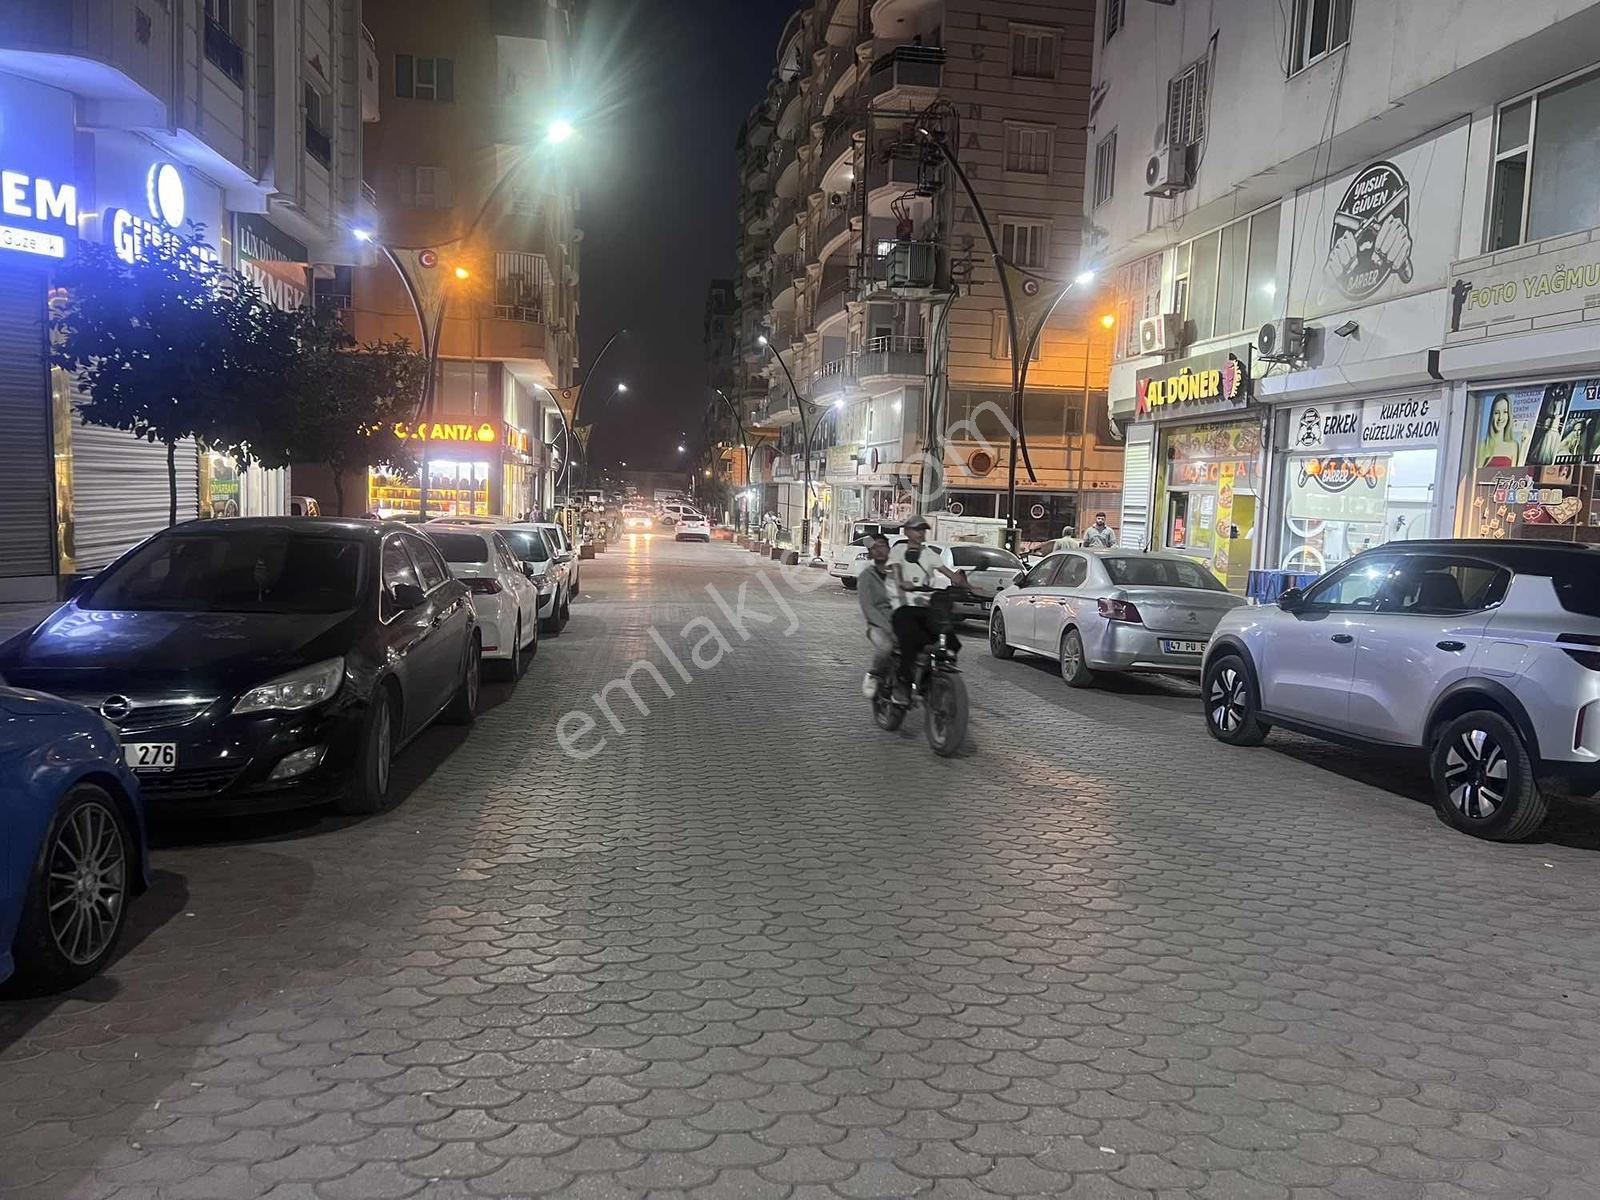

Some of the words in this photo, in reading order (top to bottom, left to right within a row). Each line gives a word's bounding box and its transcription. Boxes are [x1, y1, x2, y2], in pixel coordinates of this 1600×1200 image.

[1353, 171, 1390, 200] YUSUF
[2, 170, 76, 226] EM
[1352, 189, 1389, 216] GÜVEN
[1467, 281, 1518, 311] FOTO
[1167, 367, 1220, 404] DÖNER
[1380, 398, 1418, 420] KUAFÖR
[1420, 400, 1430, 416] &
[1323, 413, 1358, 435] ERKEK
[1405, 420, 1441, 439] SALON
[1170, 641, 1181, 651] 47
[138, 745, 174, 765] 276
